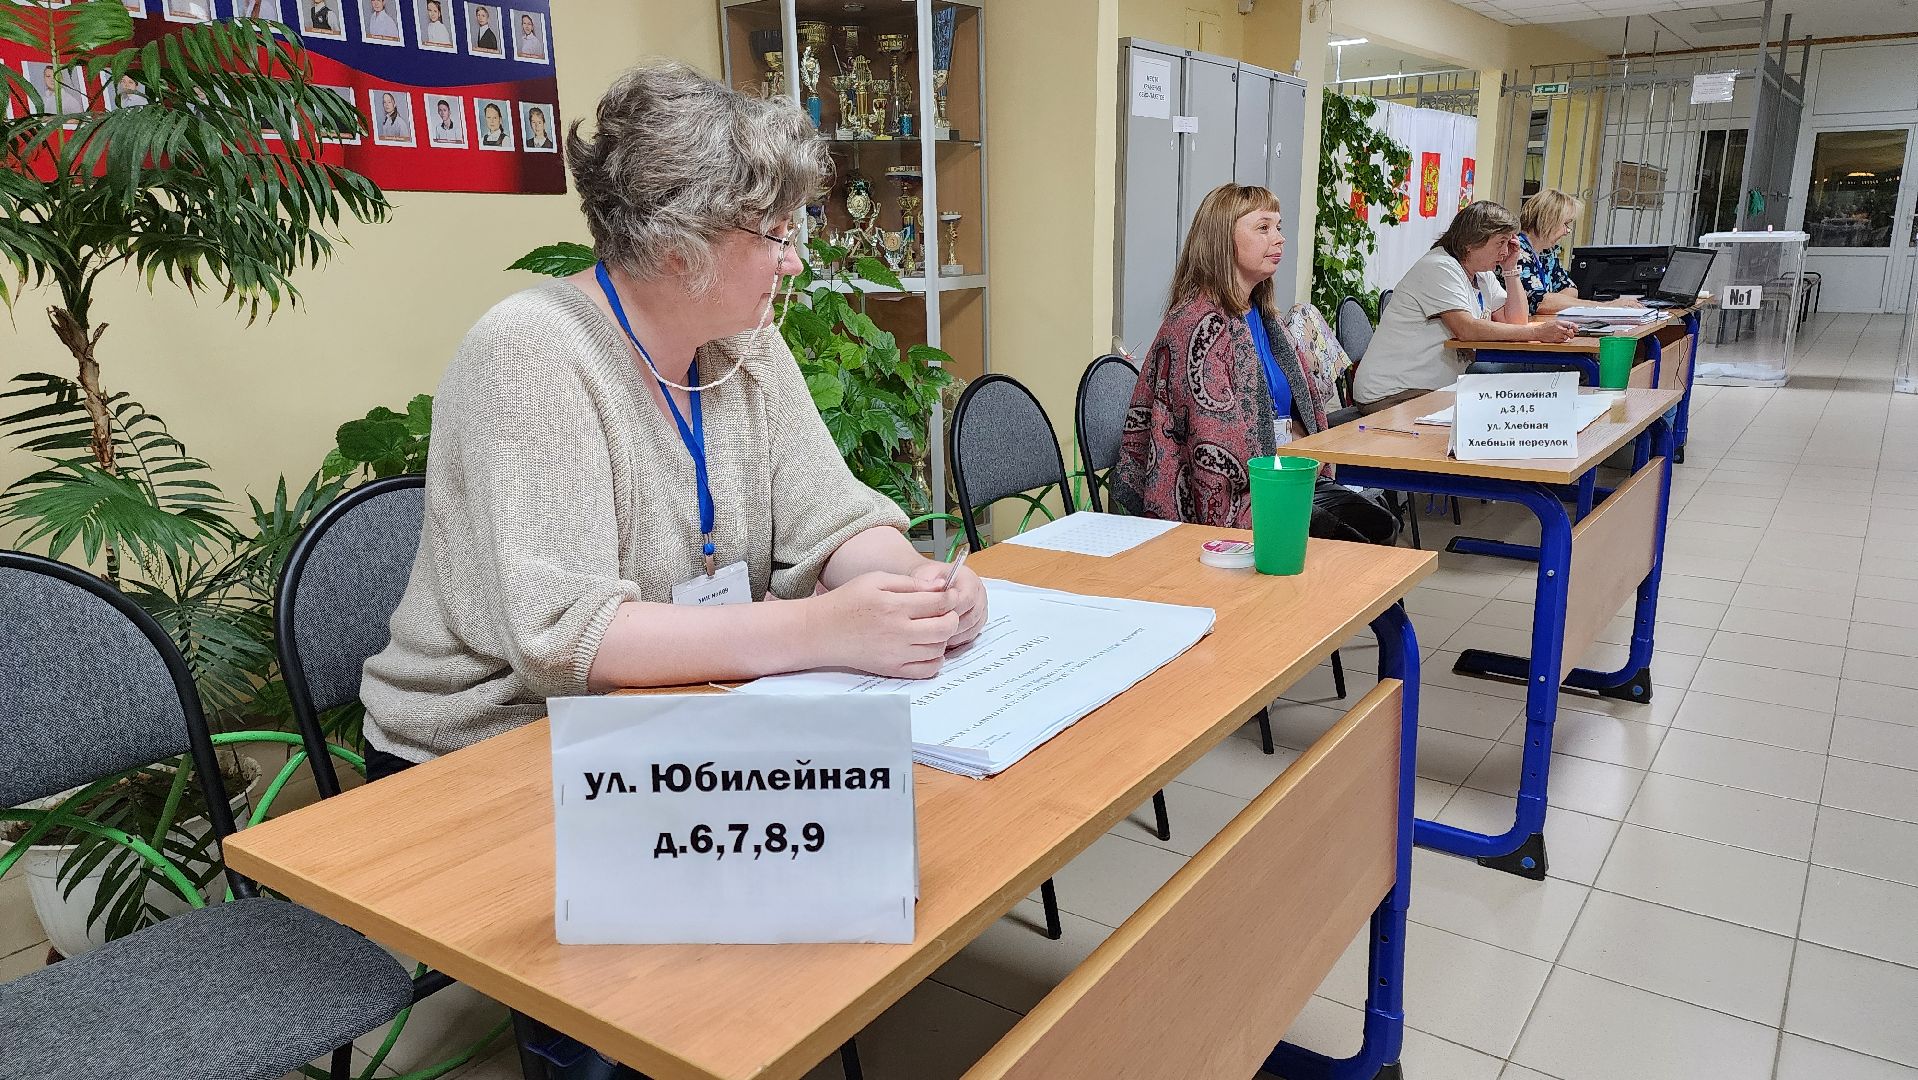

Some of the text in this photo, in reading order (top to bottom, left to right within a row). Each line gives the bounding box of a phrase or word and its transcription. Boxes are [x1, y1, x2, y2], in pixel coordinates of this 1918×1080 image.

[1730, 289, 1752, 305] №1
[1478, 389, 1558, 400] ул. Юбилейная
[1487, 421, 1549, 432] ул. Хлебная
[1468, 437, 1569, 447] Хлебный переулок
[583, 760, 891, 801] ул. Юбилейная
[653, 822, 825, 861] д.6,7,8,9
